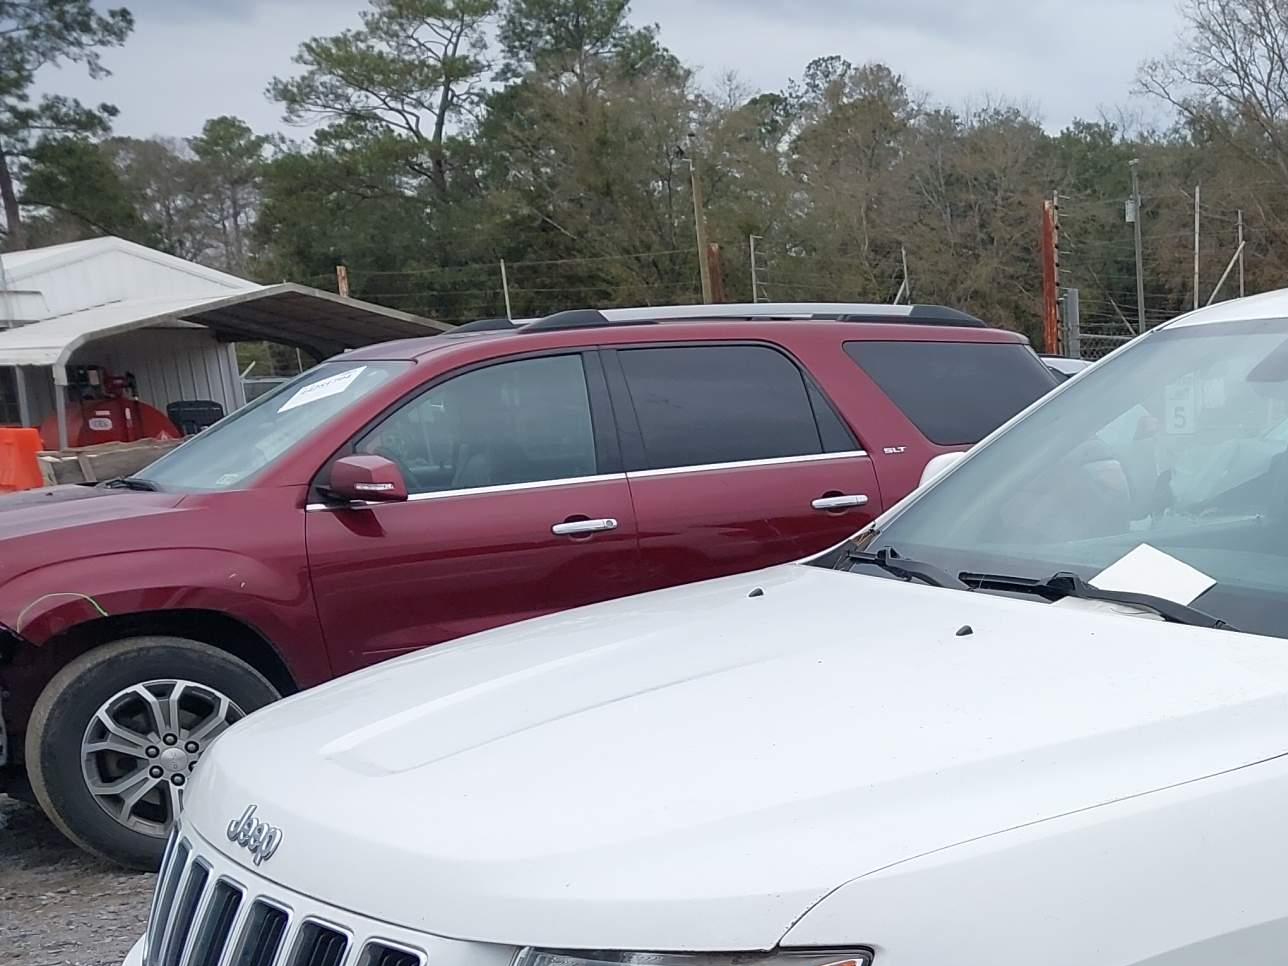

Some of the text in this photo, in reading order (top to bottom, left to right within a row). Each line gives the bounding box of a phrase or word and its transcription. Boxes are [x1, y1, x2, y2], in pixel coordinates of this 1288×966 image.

[1174, 406, 1187, 429] 5
[883, 446, 907, 454] SLT
[226, 804, 283, 867] Jeep
